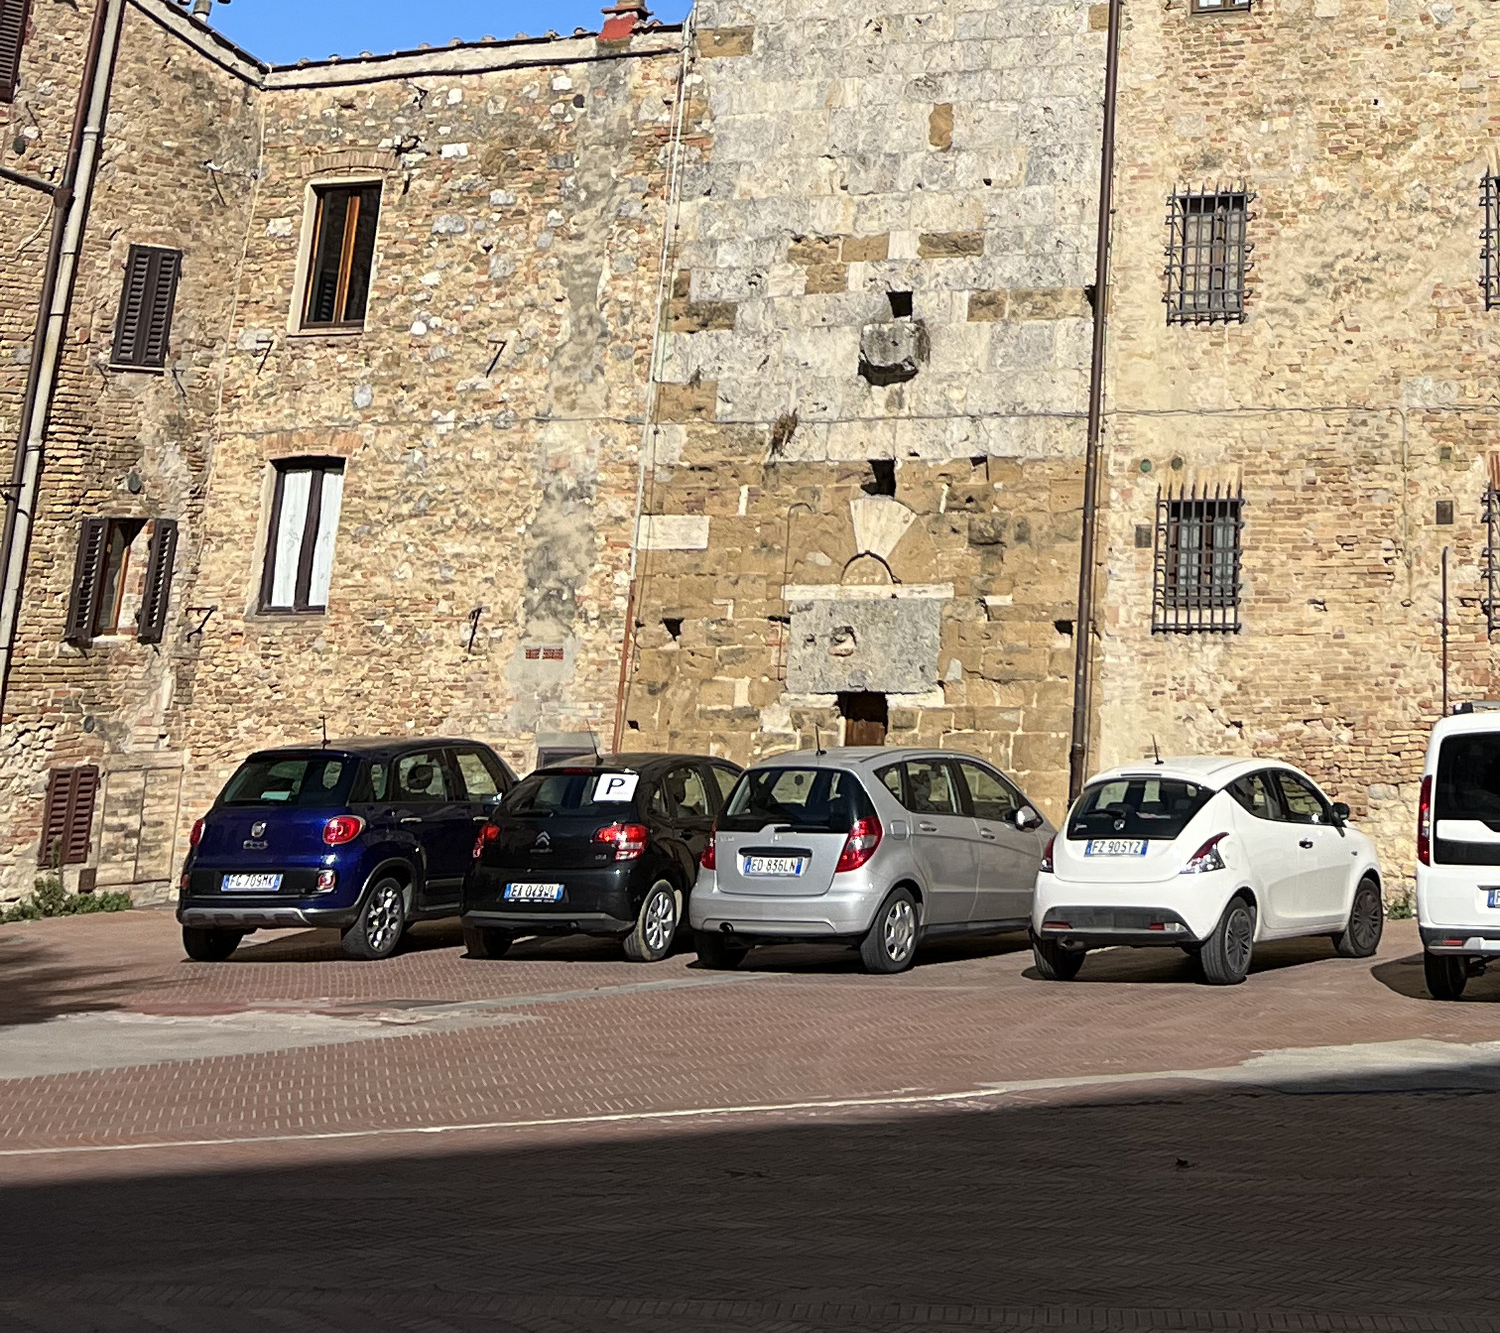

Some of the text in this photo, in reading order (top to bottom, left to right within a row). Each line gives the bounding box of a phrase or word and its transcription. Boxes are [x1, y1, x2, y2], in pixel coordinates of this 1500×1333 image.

[605, 777, 626, 795] P
[1092, 840, 1141, 854] FZ 905YZ
[751, 858, 796, 873] ED 836LN
